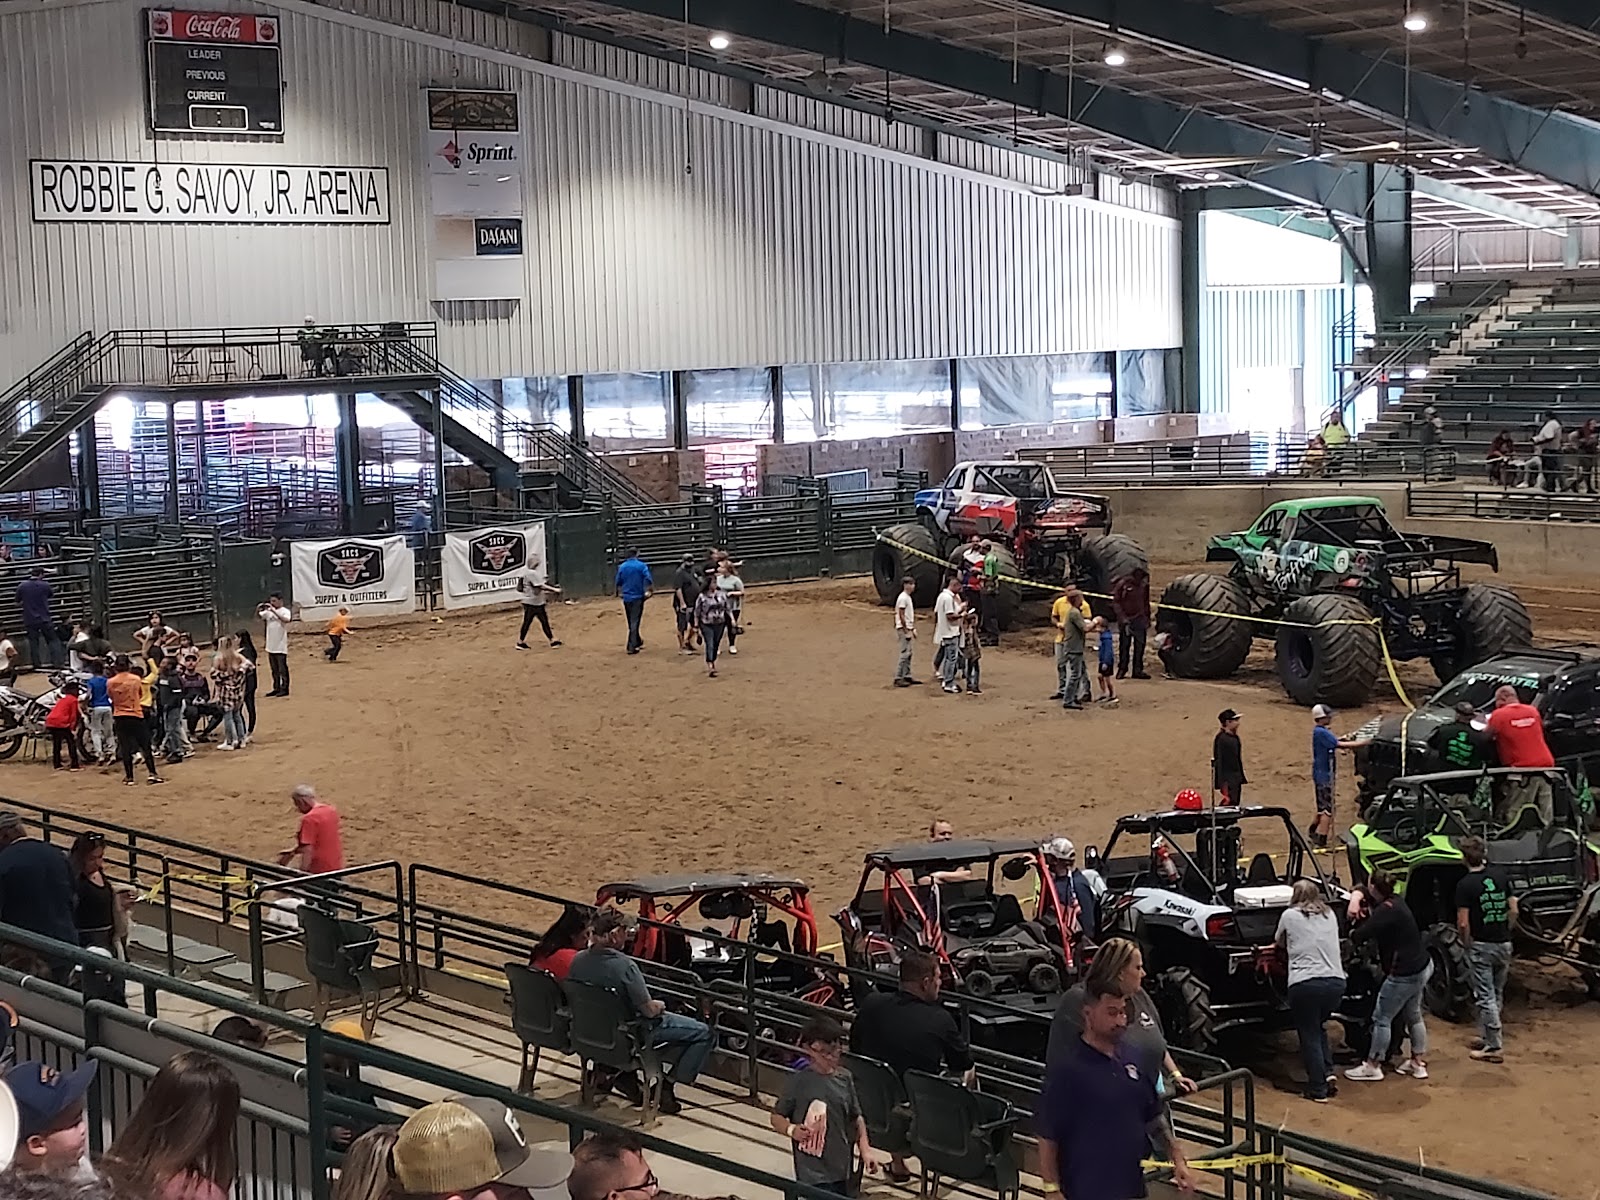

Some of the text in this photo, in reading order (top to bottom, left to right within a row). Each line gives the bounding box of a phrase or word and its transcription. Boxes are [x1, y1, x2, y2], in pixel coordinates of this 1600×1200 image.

[186, 15, 241, 38] Coca-Cola
[188, 49, 221, 59] LEADER
[186, 70, 226, 80] PREVIOUS
[187, 90, 226, 101] CURRENT
[467, 143, 513, 164] Sprint
[41, 165, 381, 218] ROBBIE G. SAVOY, JR. ARENA
[480, 227, 518, 246] DASANI
[341, 549, 359, 558] SACS
[468, 582, 489, 592] SUPPLY
[315, 591, 387, 604] SUPPLY & OUTFITTERS
[1163, 899, 1197, 916] Kawasaki
